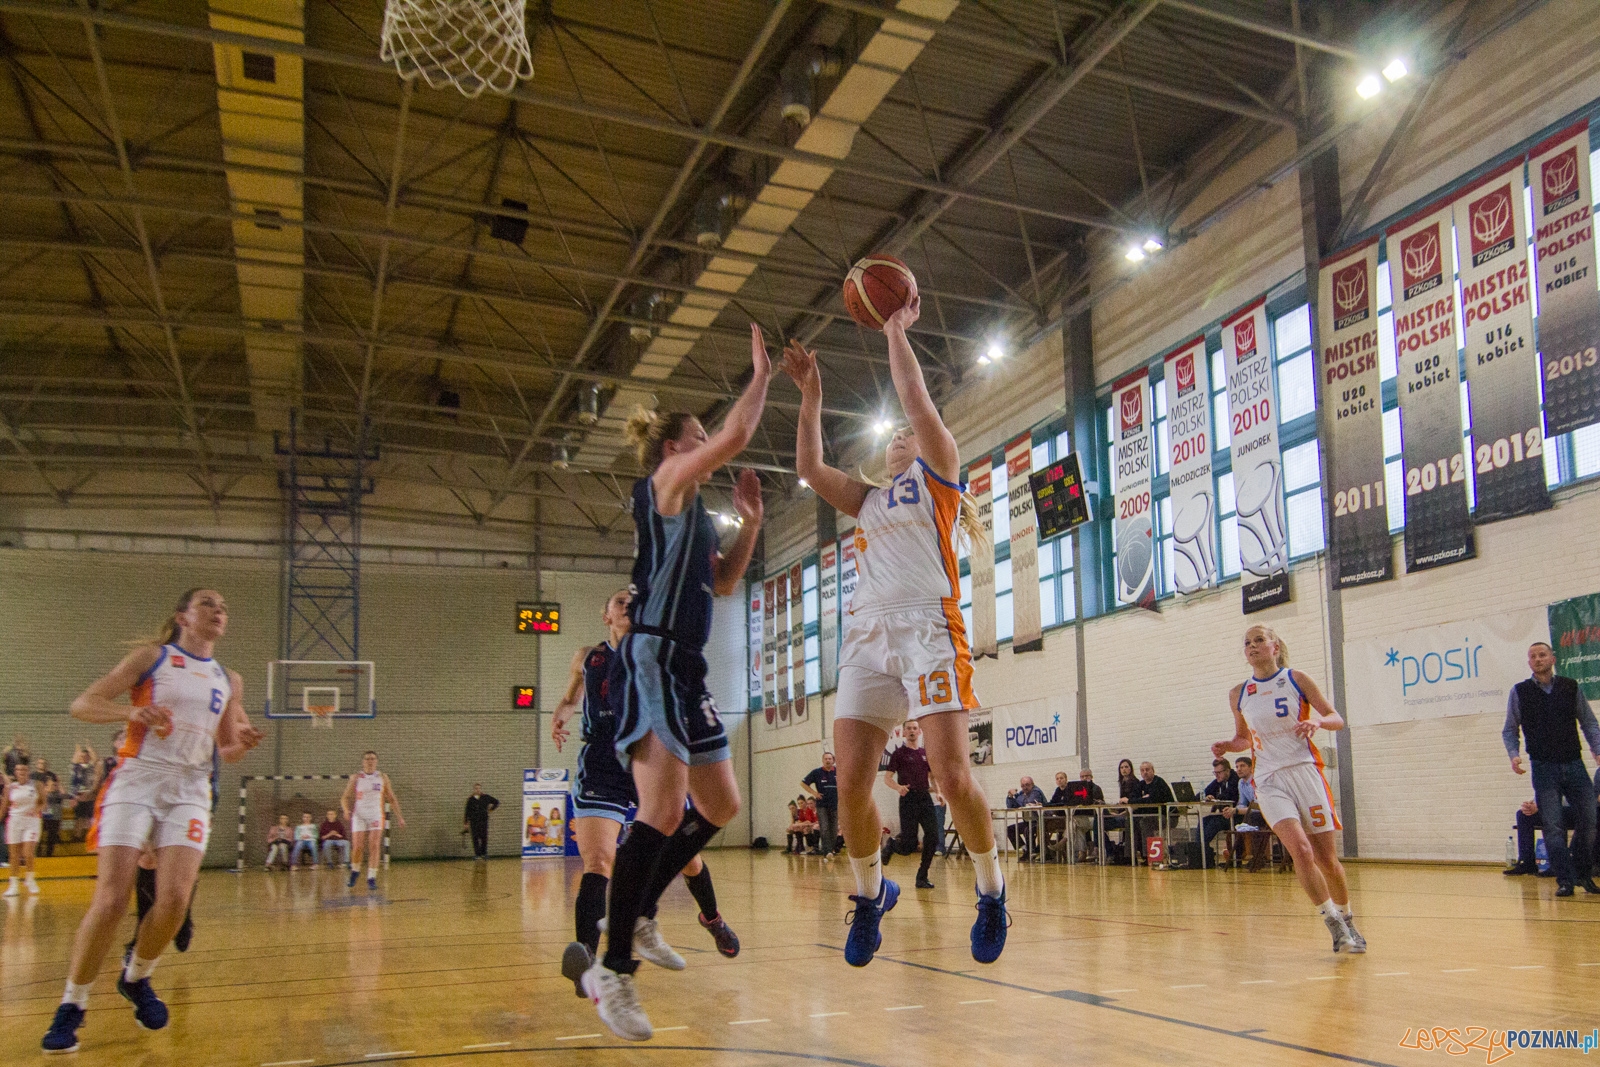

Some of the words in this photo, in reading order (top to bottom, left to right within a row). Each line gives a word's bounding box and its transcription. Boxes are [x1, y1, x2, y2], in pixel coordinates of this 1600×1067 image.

[1537, 205, 1591, 242] MISTRZ
[1538, 225, 1591, 262] POLSKI
[1554, 256, 1577, 274] U16
[1464, 259, 1528, 306] MISTRZ
[1545, 266, 1588, 293] KOBIET
[1396, 293, 1454, 337] MISTRZ
[1486, 323, 1513, 345] U16
[1415, 354, 1440, 374] U20
[1478, 336, 1524, 366] kobiet
[1547, 347, 1597, 381] 2013
[1229, 356, 1268, 392] MISTRZ
[1408, 367, 1450, 393] kobiet
[1230, 375, 1269, 409] POLSKI
[1343, 385, 1366, 402] U20
[1171, 392, 1205, 422] MISTRZ
[1233, 398, 1270, 436] 2010
[1337, 398, 1374, 420] kobiet
[1171, 411, 1206, 440] POLSKI
[1118, 436, 1148, 462] MISTRZ
[1173, 433, 1206, 465] 2010
[1237, 433, 1271, 458] JUNIOREK
[1476, 427, 1542, 474] 2012
[1118, 454, 1149, 479] POLSKI
[1171, 463, 1211, 488] MŁODZICZEK
[1406, 453, 1464, 496] 2012
[887, 478, 920, 509] 13
[1120, 477, 1149, 493] JUNIOREK
[1010, 498, 1033, 520] POLSKI
[1120, 492, 1150, 520] 2009
[1334, 481, 1383, 517] 2011
[1416, 545, 1466, 565] www.pzkosz.pl
[209, 688, 223, 714] 6
[918, 671, 952, 706] 13
[1274, 697, 1289, 717] 5
[1309, 805, 1326, 827] 5
[187, 818, 204, 843] 6
[1149, 841, 1161, 858] 5
